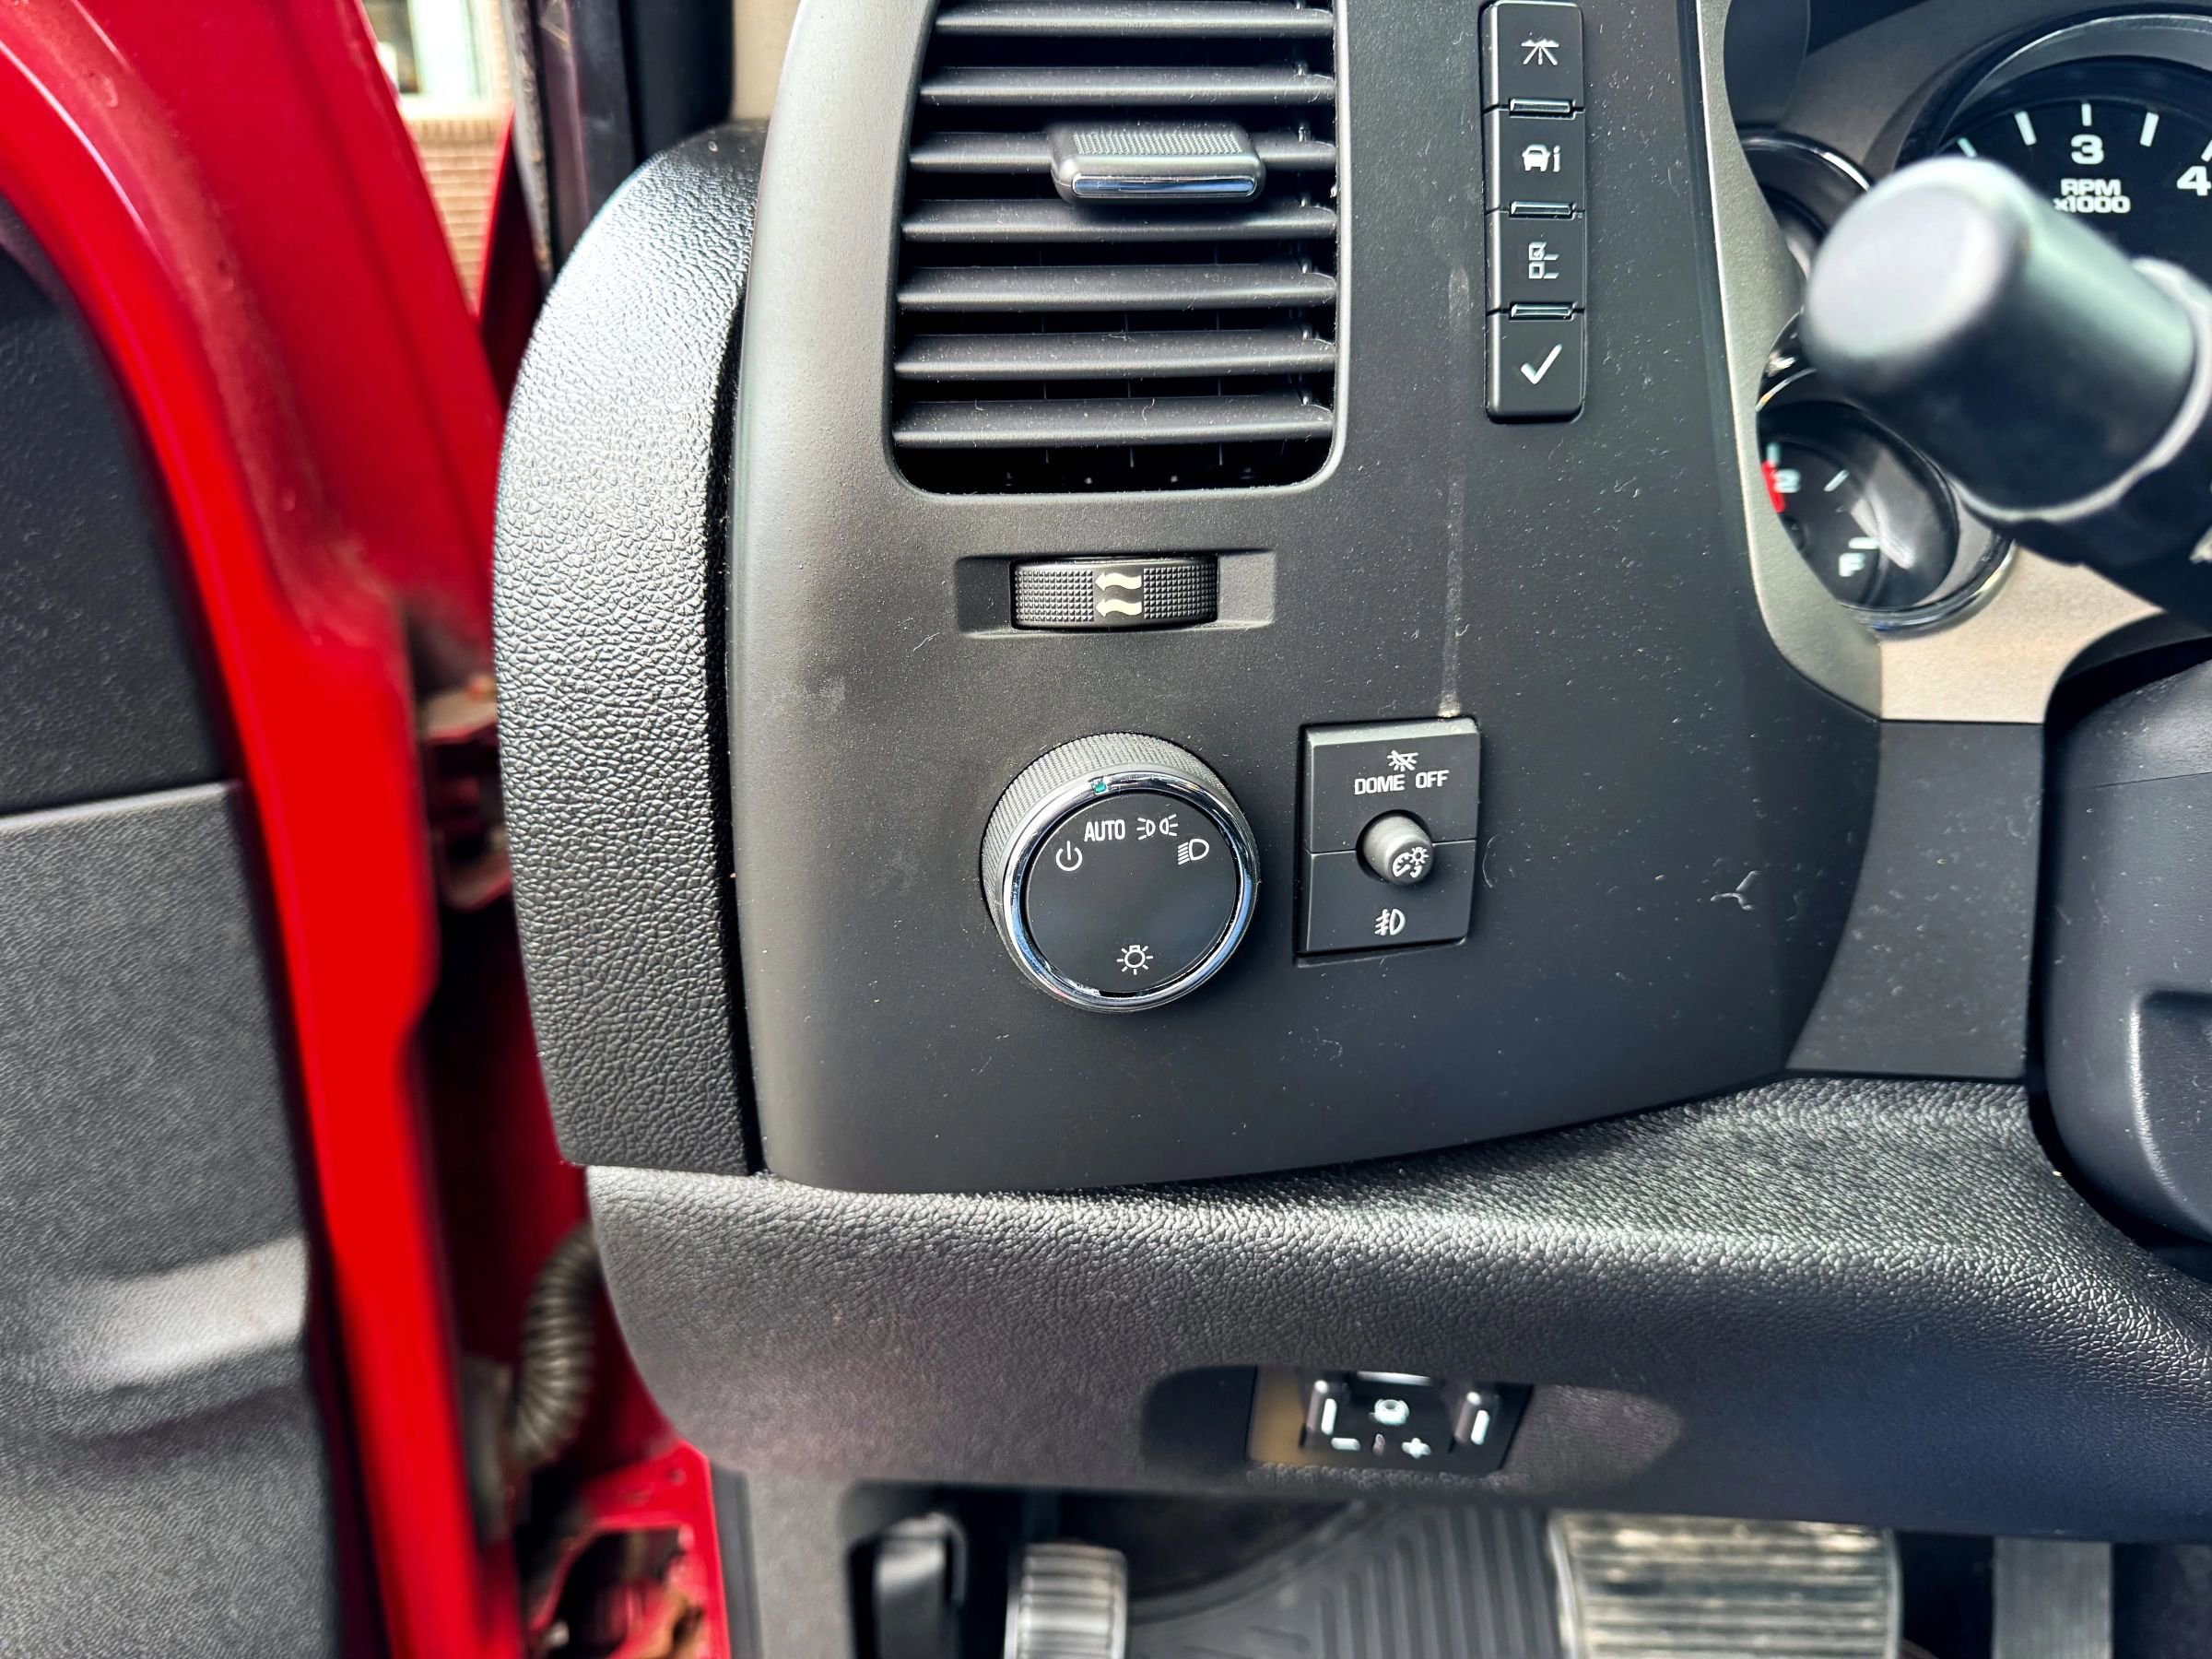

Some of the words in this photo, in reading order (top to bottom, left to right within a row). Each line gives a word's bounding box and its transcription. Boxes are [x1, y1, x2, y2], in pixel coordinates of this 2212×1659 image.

[2070, 134, 2105, 165] 3
[2060, 178, 2122, 196] RPM
[2176, 165, 2212, 196] 4
[1839, 552, 1865, 577] F
[1354, 774, 1406, 795] DOME
[1415, 770, 1450, 789] OFF
[1084, 819, 1126, 842] AUTO
